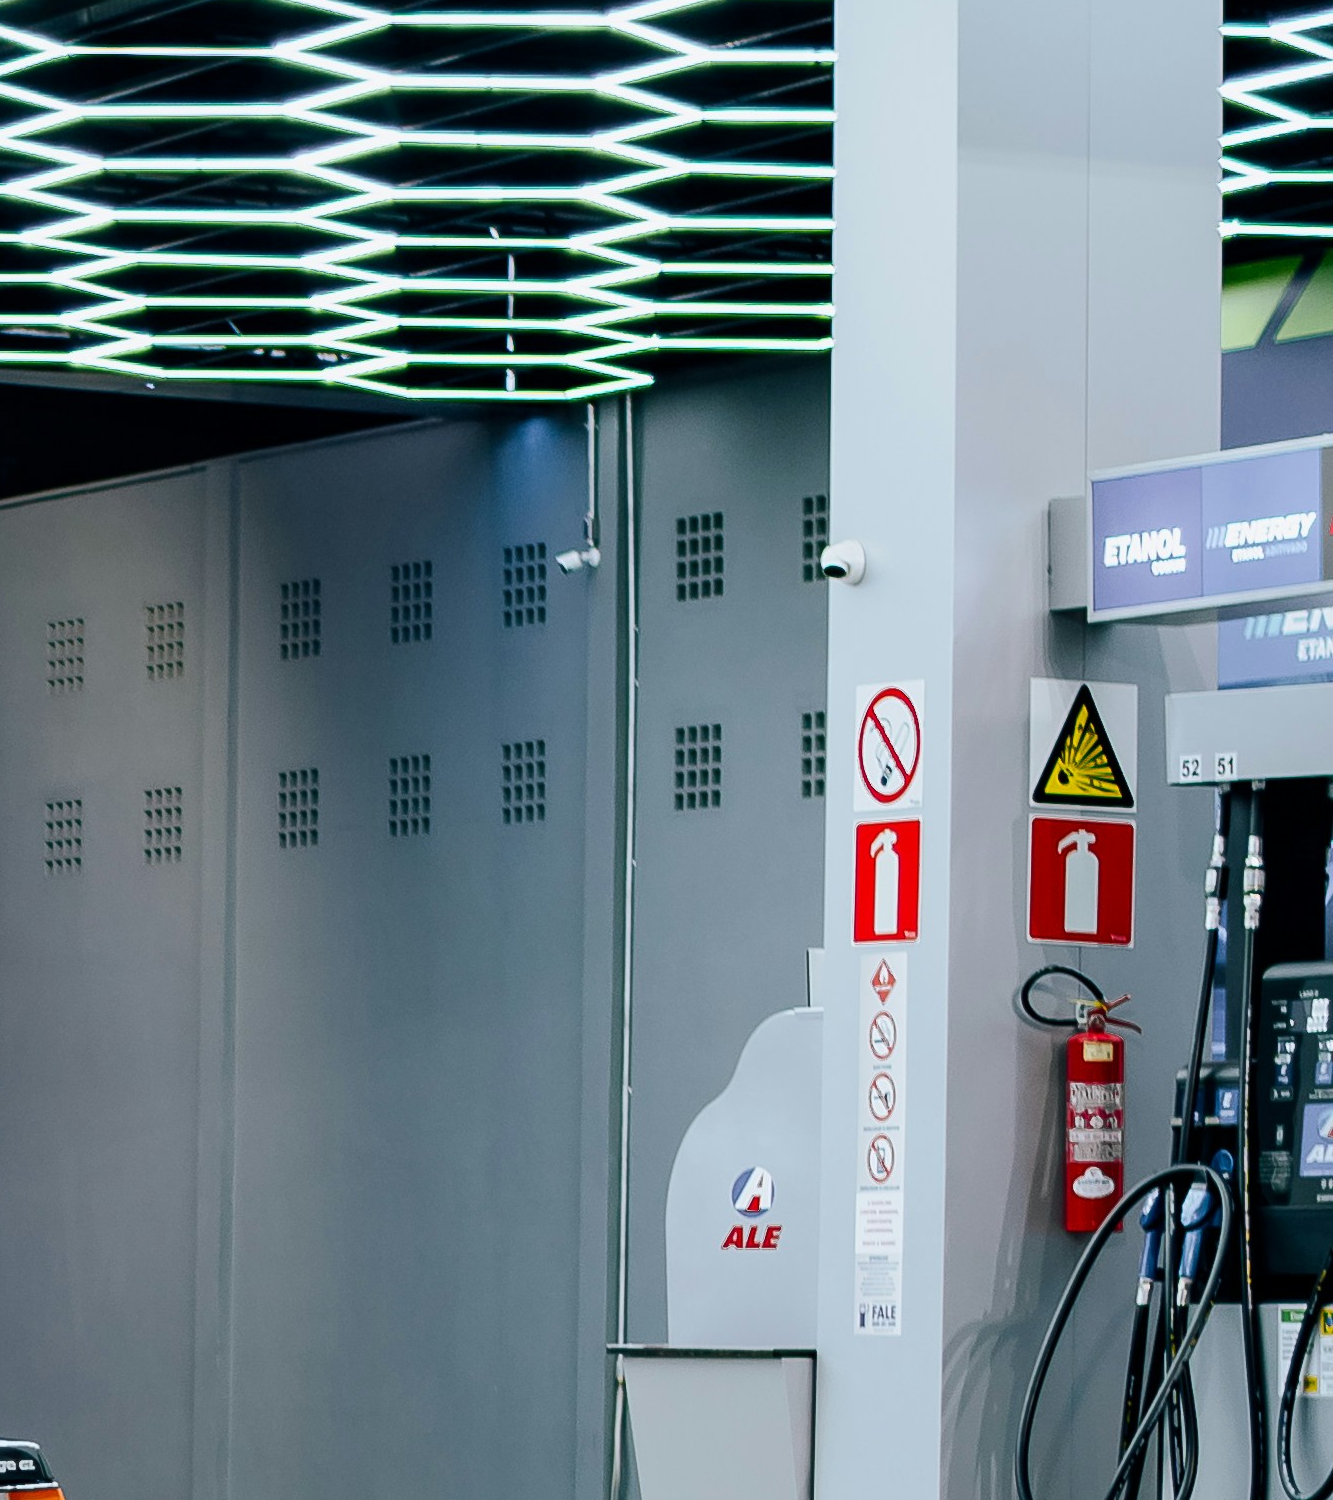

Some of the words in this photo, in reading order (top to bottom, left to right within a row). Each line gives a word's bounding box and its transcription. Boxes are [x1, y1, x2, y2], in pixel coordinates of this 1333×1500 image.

[1224, 512, 1317, 548] ENERGY
[1104, 527, 1186, 568] ETANOL
[1182, 759, 1200, 777] 52
[1217, 756, 1234, 775] 51
[721, 1224, 782, 1250] ALE
[872, 1304, 896, 1319] FALE
